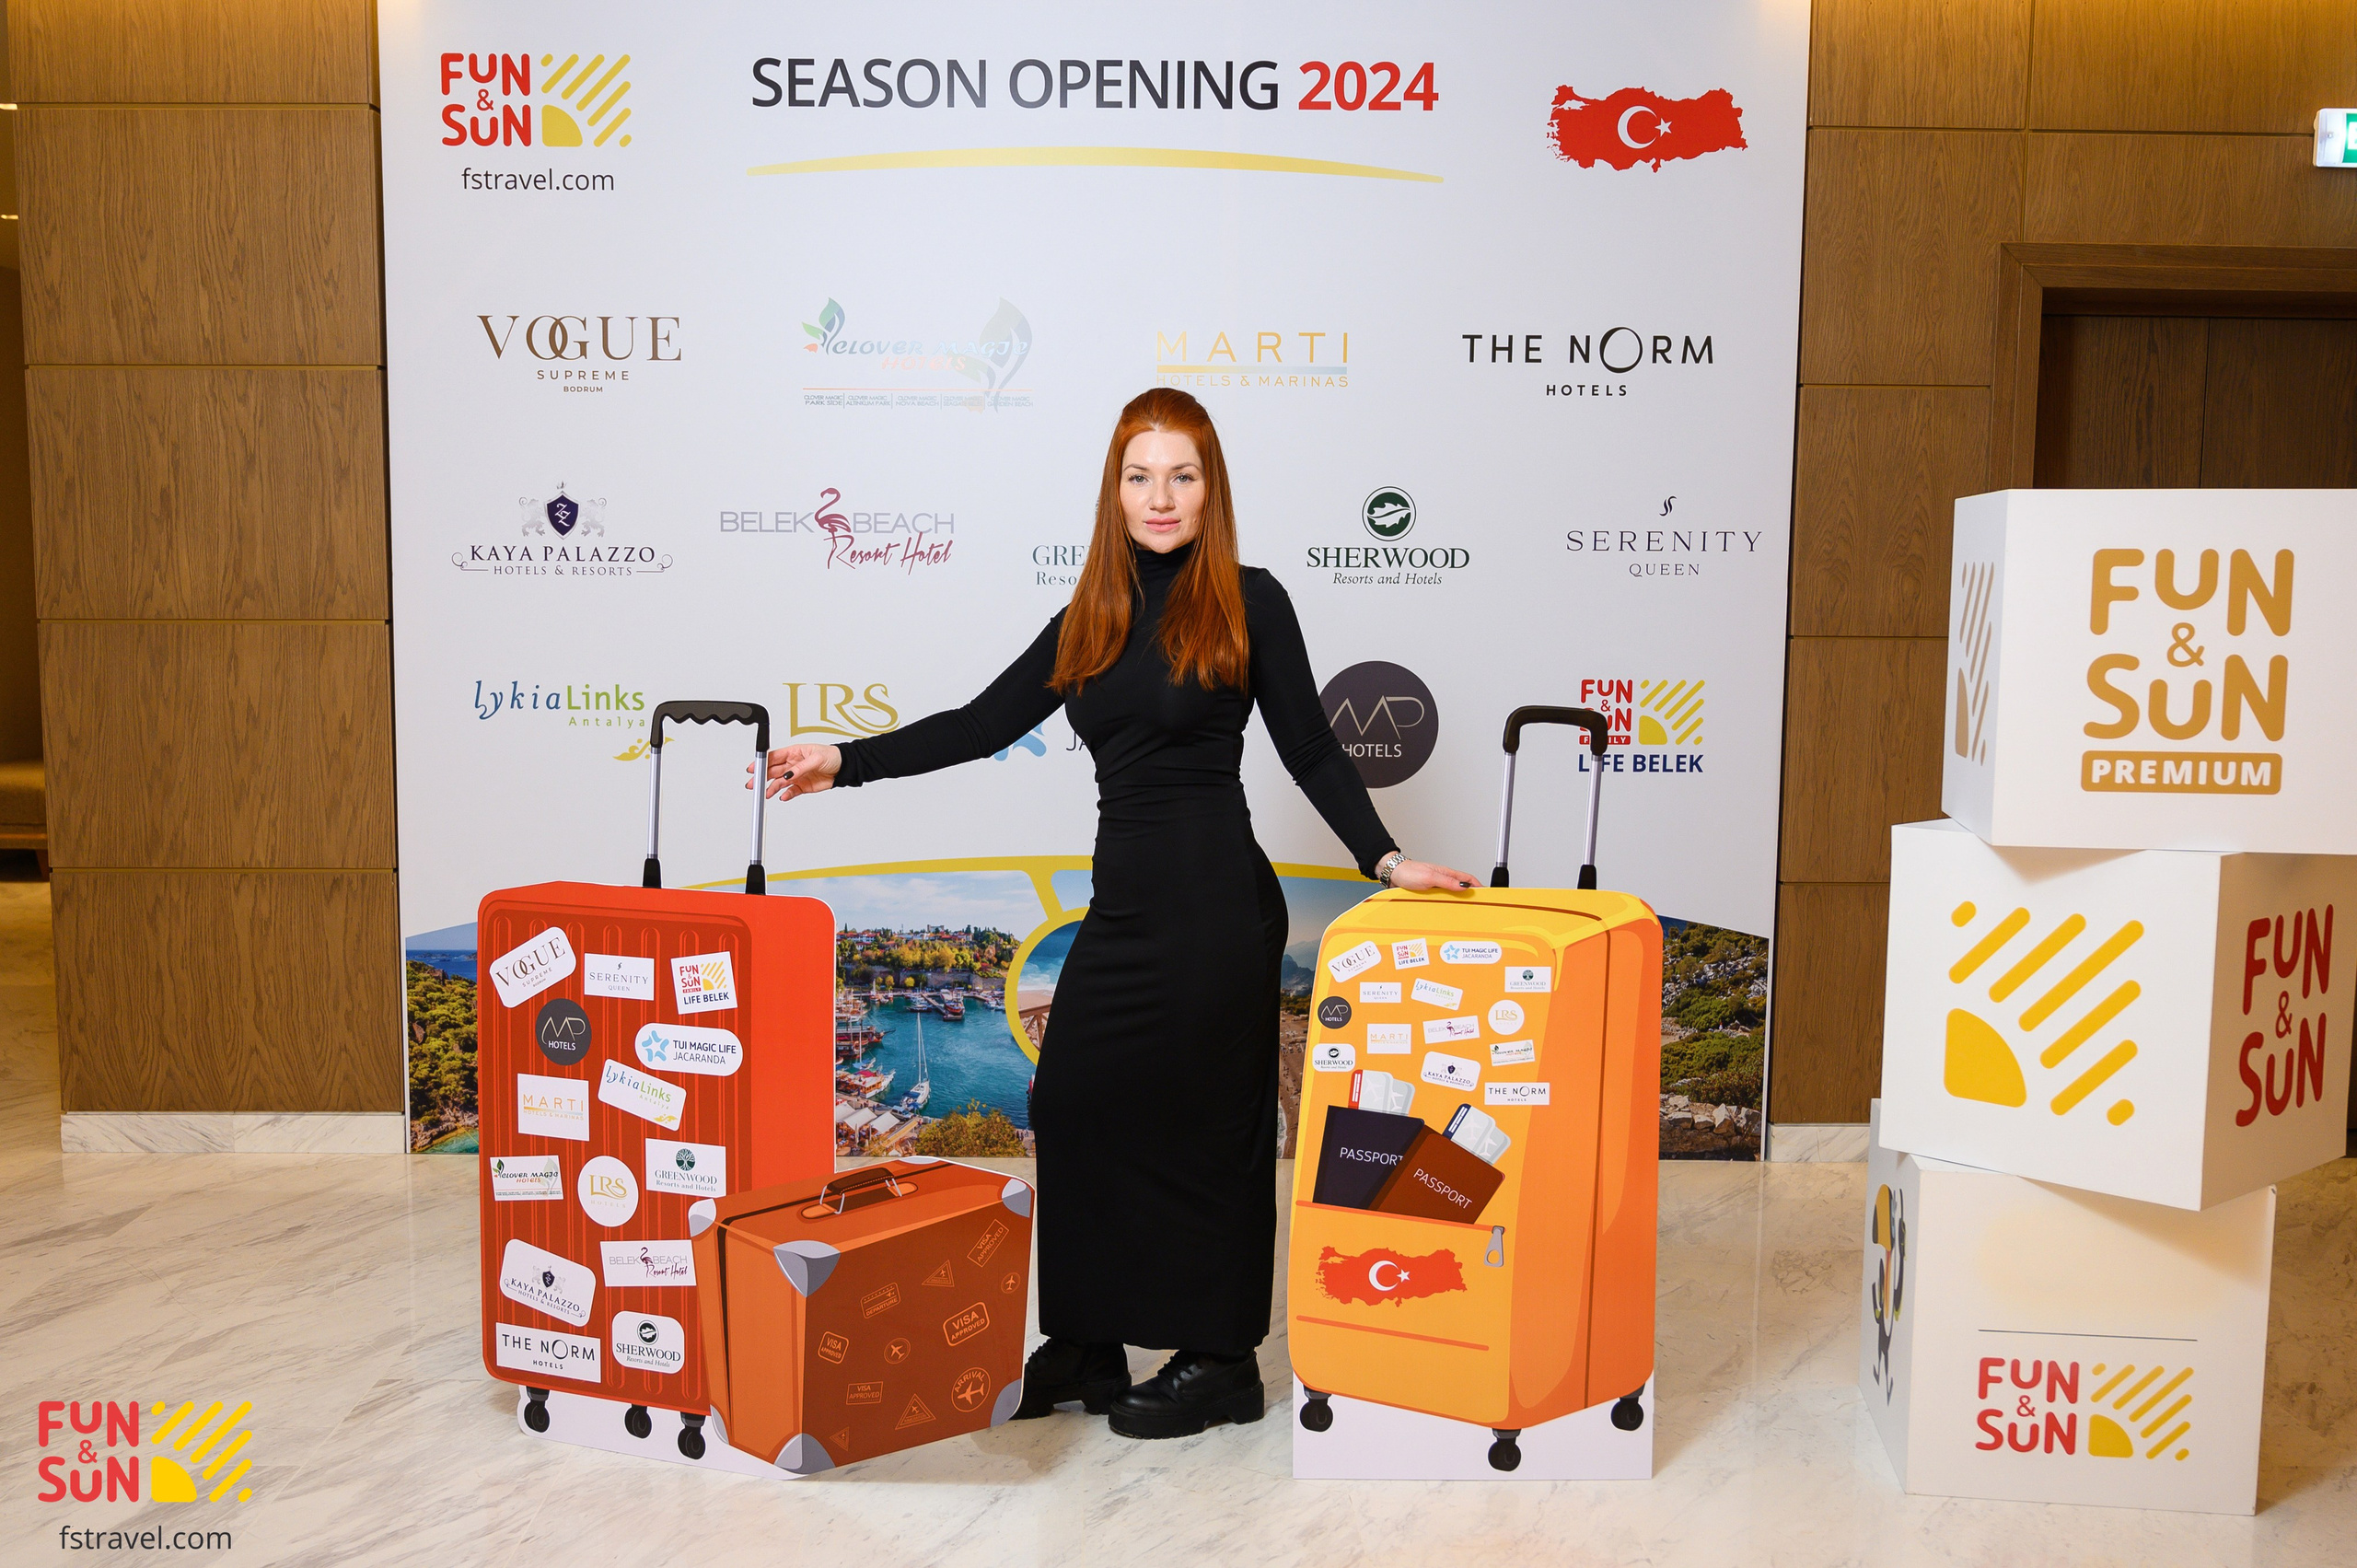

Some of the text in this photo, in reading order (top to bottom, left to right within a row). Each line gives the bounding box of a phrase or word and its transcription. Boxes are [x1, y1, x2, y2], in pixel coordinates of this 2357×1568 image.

[440, 52, 531, 96] FUN
[751, 57, 1439, 111] SEASON OPENING 2024
[476, 88, 494, 111] &
[441, 103, 532, 147] SUN
[461, 167, 615, 192] fstravel.com
[476, 314, 682, 362] VOGUE
[832, 340, 923, 355] CLOVER
[1156, 331, 1348, 364] MARTI
[1462, 326, 1714, 374] THE NORM
[537, 370, 630, 381] SUPREME
[1155, 375, 1349, 388] HOTELS & MARINAS
[563, 385, 604, 393] BODRUM
[1546, 384, 1628, 397] HOTELS
[720, 510, 955, 535] BELEK BEACH
[1565, 530, 1763, 552] SERENITY
[470, 544, 656, 563] KAYA PALAZZO
[825, 531, 954, 575] Resort Hotel
[1306, 547, 1470, 569] SHERWOOD
[493, 565, 633, 576] HOTELS & RESORTS
[1332, 572, 1443, 586] Resorts and Hotels
[1629, 563, 1701, 577] QUEEN
[2089, 548, 2295, 637] FUN
[2166, 621, 2205, 668] &
[1580, 679, 1633, 704] FUN
[2083, 653, 2289, 742] SUN
[782, 681, 901, 738] LRS
[1600, 699, 1611, 712] &
[568, 715, 645, 730] Antalya
[1584, 736, 1627, 744] FILY
[1578, 753, 1704, 773] LFE BELEK
[2091, 759, 2272, 787] PREMIUM
[495, 936, 565, 987] VOGUE
[2243, 903, 2334, 1016] FUN
[522, 967, 552, 988] SUPREME
[589, 971, 649, 984] SERENITY
[679, 964, 699, 977] FUN
[680, 976, 701, 988] SUN
[683, 992, 730, 1005] LIFE BELEK
[2275, 990, 2293, 1039] &
[548, 1040, 576, 1051] HOTELS
[673, 1040, 737, 1054] TUI MAGIC LIFE
[673, 1051, 726, 1065] JACARANDA
[1444, 1074, 1471, 1085] PALAZZO
[2235, 1012, 2327, 1127] SUN
[1512, 1086, 1546, 1097] NORM
[523, 1094, 584, 1112] MARTI
[655, 1169, 718, 1185] GREENWOOD
[656, 1179, 679, 1188] Resorts
[695, 1184, 716, 1192] Hotels
[589, 1174, 628, 1201] LRS
[1412, 1167, 1473, 1209] PASSPORT
[977, 1234, 992, 1249] VISA
[977, 1226, 1004, 1262] APPROVED
[609, 1255, 688, 1265] BELEK BEACH
[510, 1278, 580, 1312] KAYA PALAZZO
[865, 1297, 898, 1317] DEPARTURE
[951, 1318, 985, 1342] APPROVED
[952, 1310, 980, 1330] VISA
[502, 1333, 595, 1361] THE NORM
[615, 1342, 681, 1362] SHERWOOD
[826, 1337, 842, 1351] VISA
[532, 1360, 563, 1369] HOTELS
[954, 1370, 985, 1393] ARRIVAL
[1978, 1357, 2080, 1404] FUN
[849, 1391, 880, 1400] APPROVED
[2016, 1395, 2036, 1418] &
[1975, 1408, 2077, 1455] SUN
